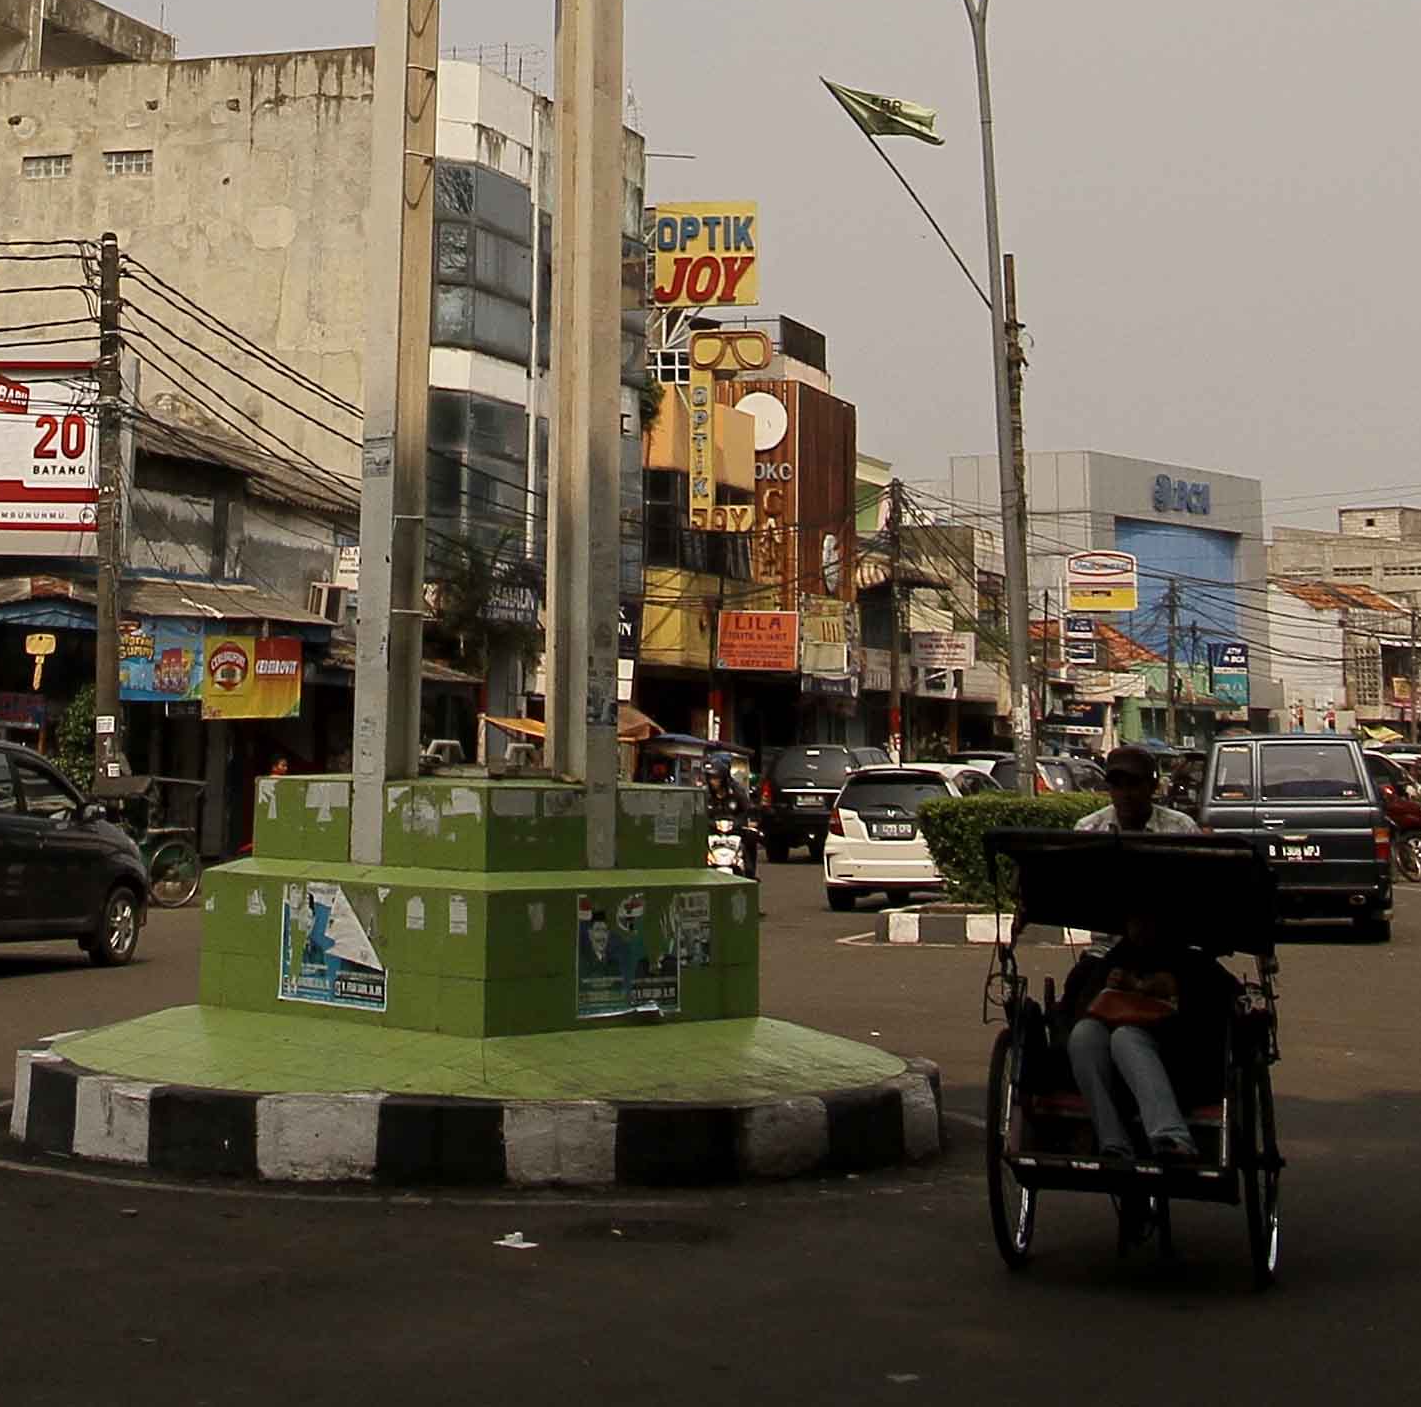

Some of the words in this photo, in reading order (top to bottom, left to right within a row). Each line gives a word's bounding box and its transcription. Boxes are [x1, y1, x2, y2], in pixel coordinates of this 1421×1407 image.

[657, 215, 755, 252] OPTIK
[654, 255, 755, 304] JOY
[33, 413, 87, 460] 20
[32, 464, 87, 476] BATANG
[754, 462, 793, 482] OKO
[691, 507, 749, 532] JOY
[734, 616, 782, 630] LILA
